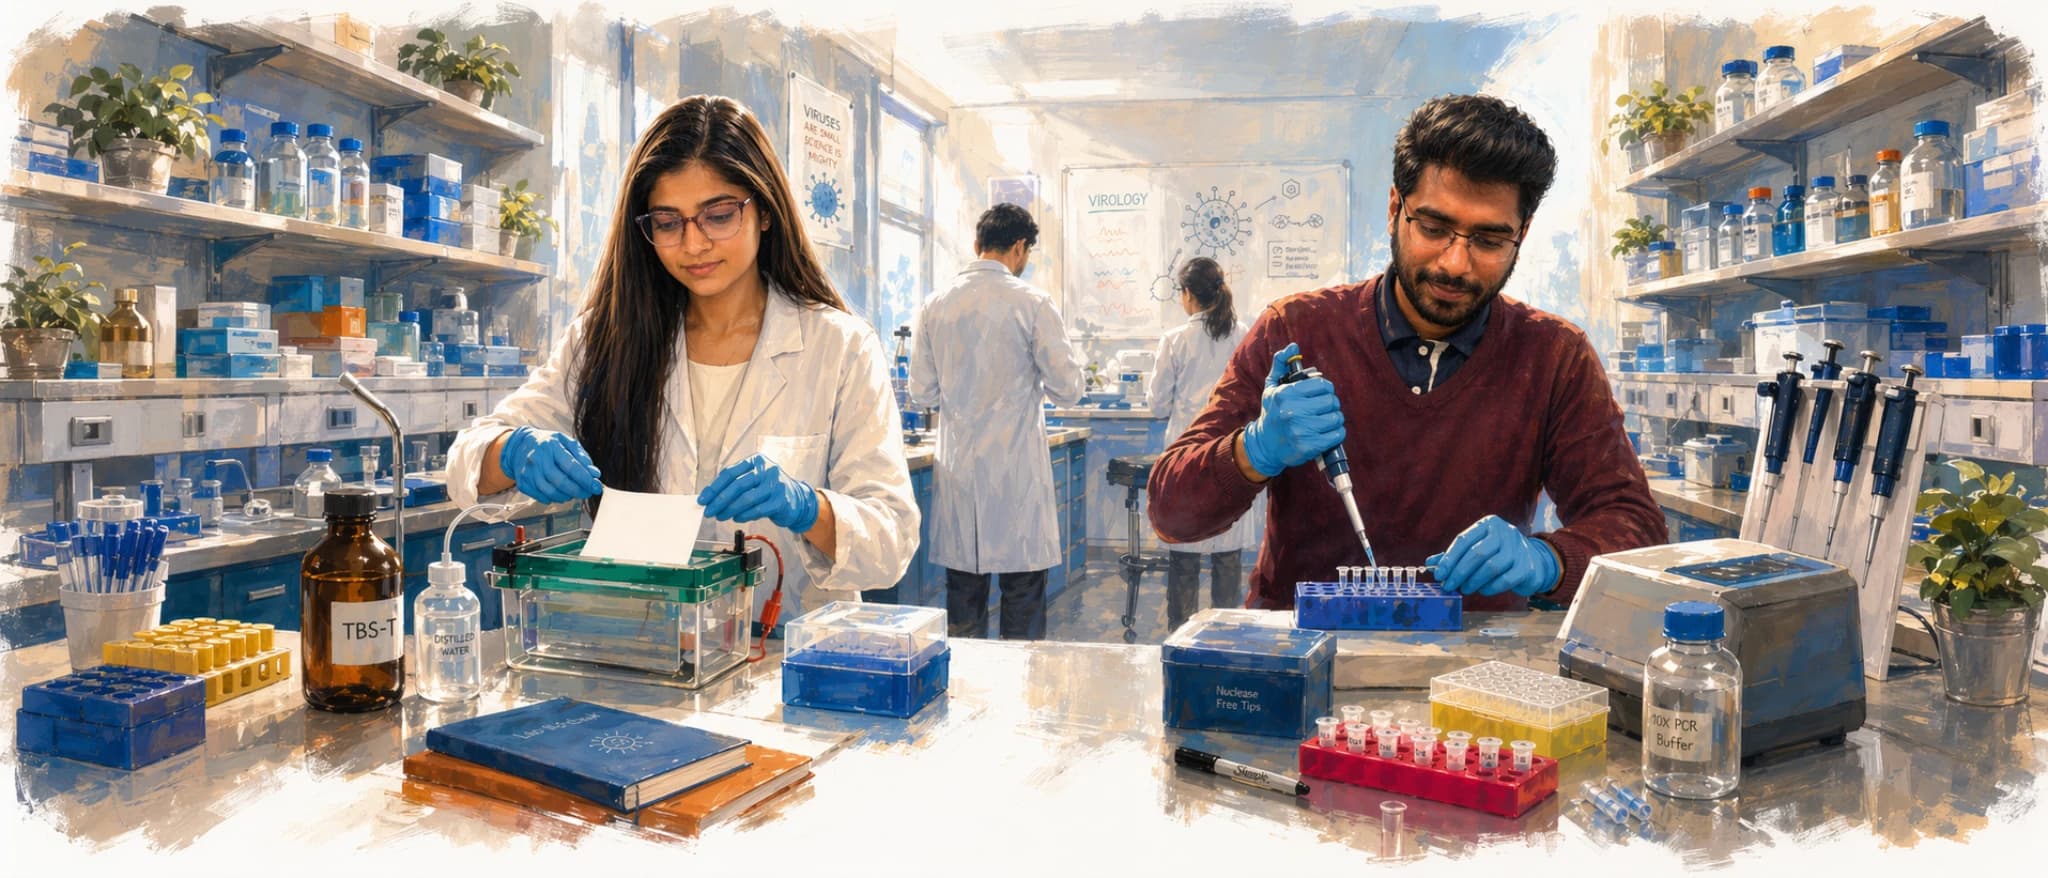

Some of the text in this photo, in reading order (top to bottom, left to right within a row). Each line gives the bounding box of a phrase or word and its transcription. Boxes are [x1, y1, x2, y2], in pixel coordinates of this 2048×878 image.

[803, 104, 841, 131] VIRUSES
[804, 121, 818, 135] ARE
[1088, 192, 1148, 207] VIROLOGY
[342, 618, 397, 640] TBS-T
[434, 632, 475, 645] DISTILLED
[441, 645, 469, 656] WATER
[1216, 685, 1259, 698] Nuclease
[1216, 699, 1261, 713] Free Tips
[1675, 719, 1698, 732] PCR
[1656, 733, 1694, 751] Buffer
